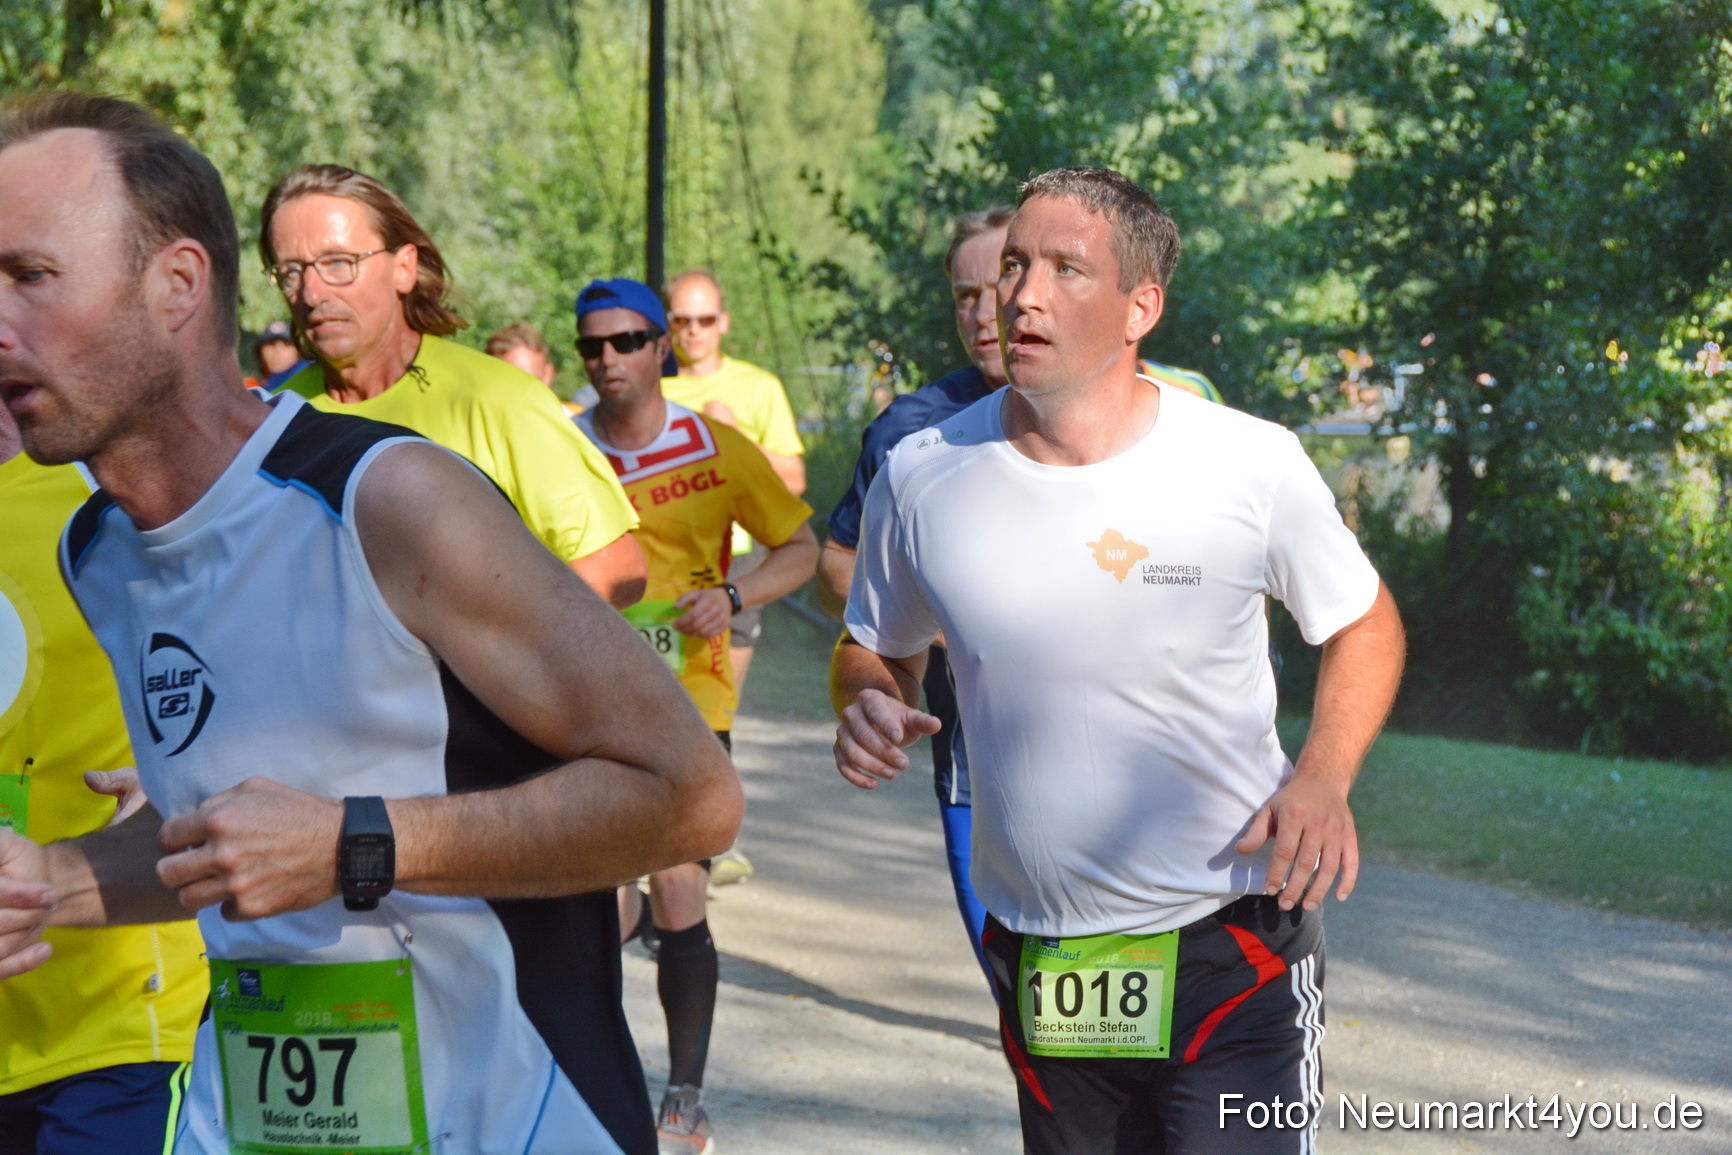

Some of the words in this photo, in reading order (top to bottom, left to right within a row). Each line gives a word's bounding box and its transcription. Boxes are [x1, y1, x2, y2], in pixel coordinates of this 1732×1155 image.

[649, 469, 727, 507] BÖGL
[1106, 549, 1127, 561] NM
[1142, 564, 1202, 576] LANDKREIS
[1142, 575, 1203, 586] NEUMARKT
[146, 668, 203, 694] saller
[1028, 971, 1148, 1018] 1018
[294, 1011, 332, 1027] 2018
[1034, 1021, 1096, 1033] Beckstein
[1099, 1021, 1137, 1033] Stefan
[1028, 1033, 1076, 1044] Landratsamt
[1077, 1035, 1116, 1044] Neumarkt
[247, 1035, 357, 1107] 797
[262, 1109, 299, 1128] Meier
[303, 1111, 358, 1129] Gerald
